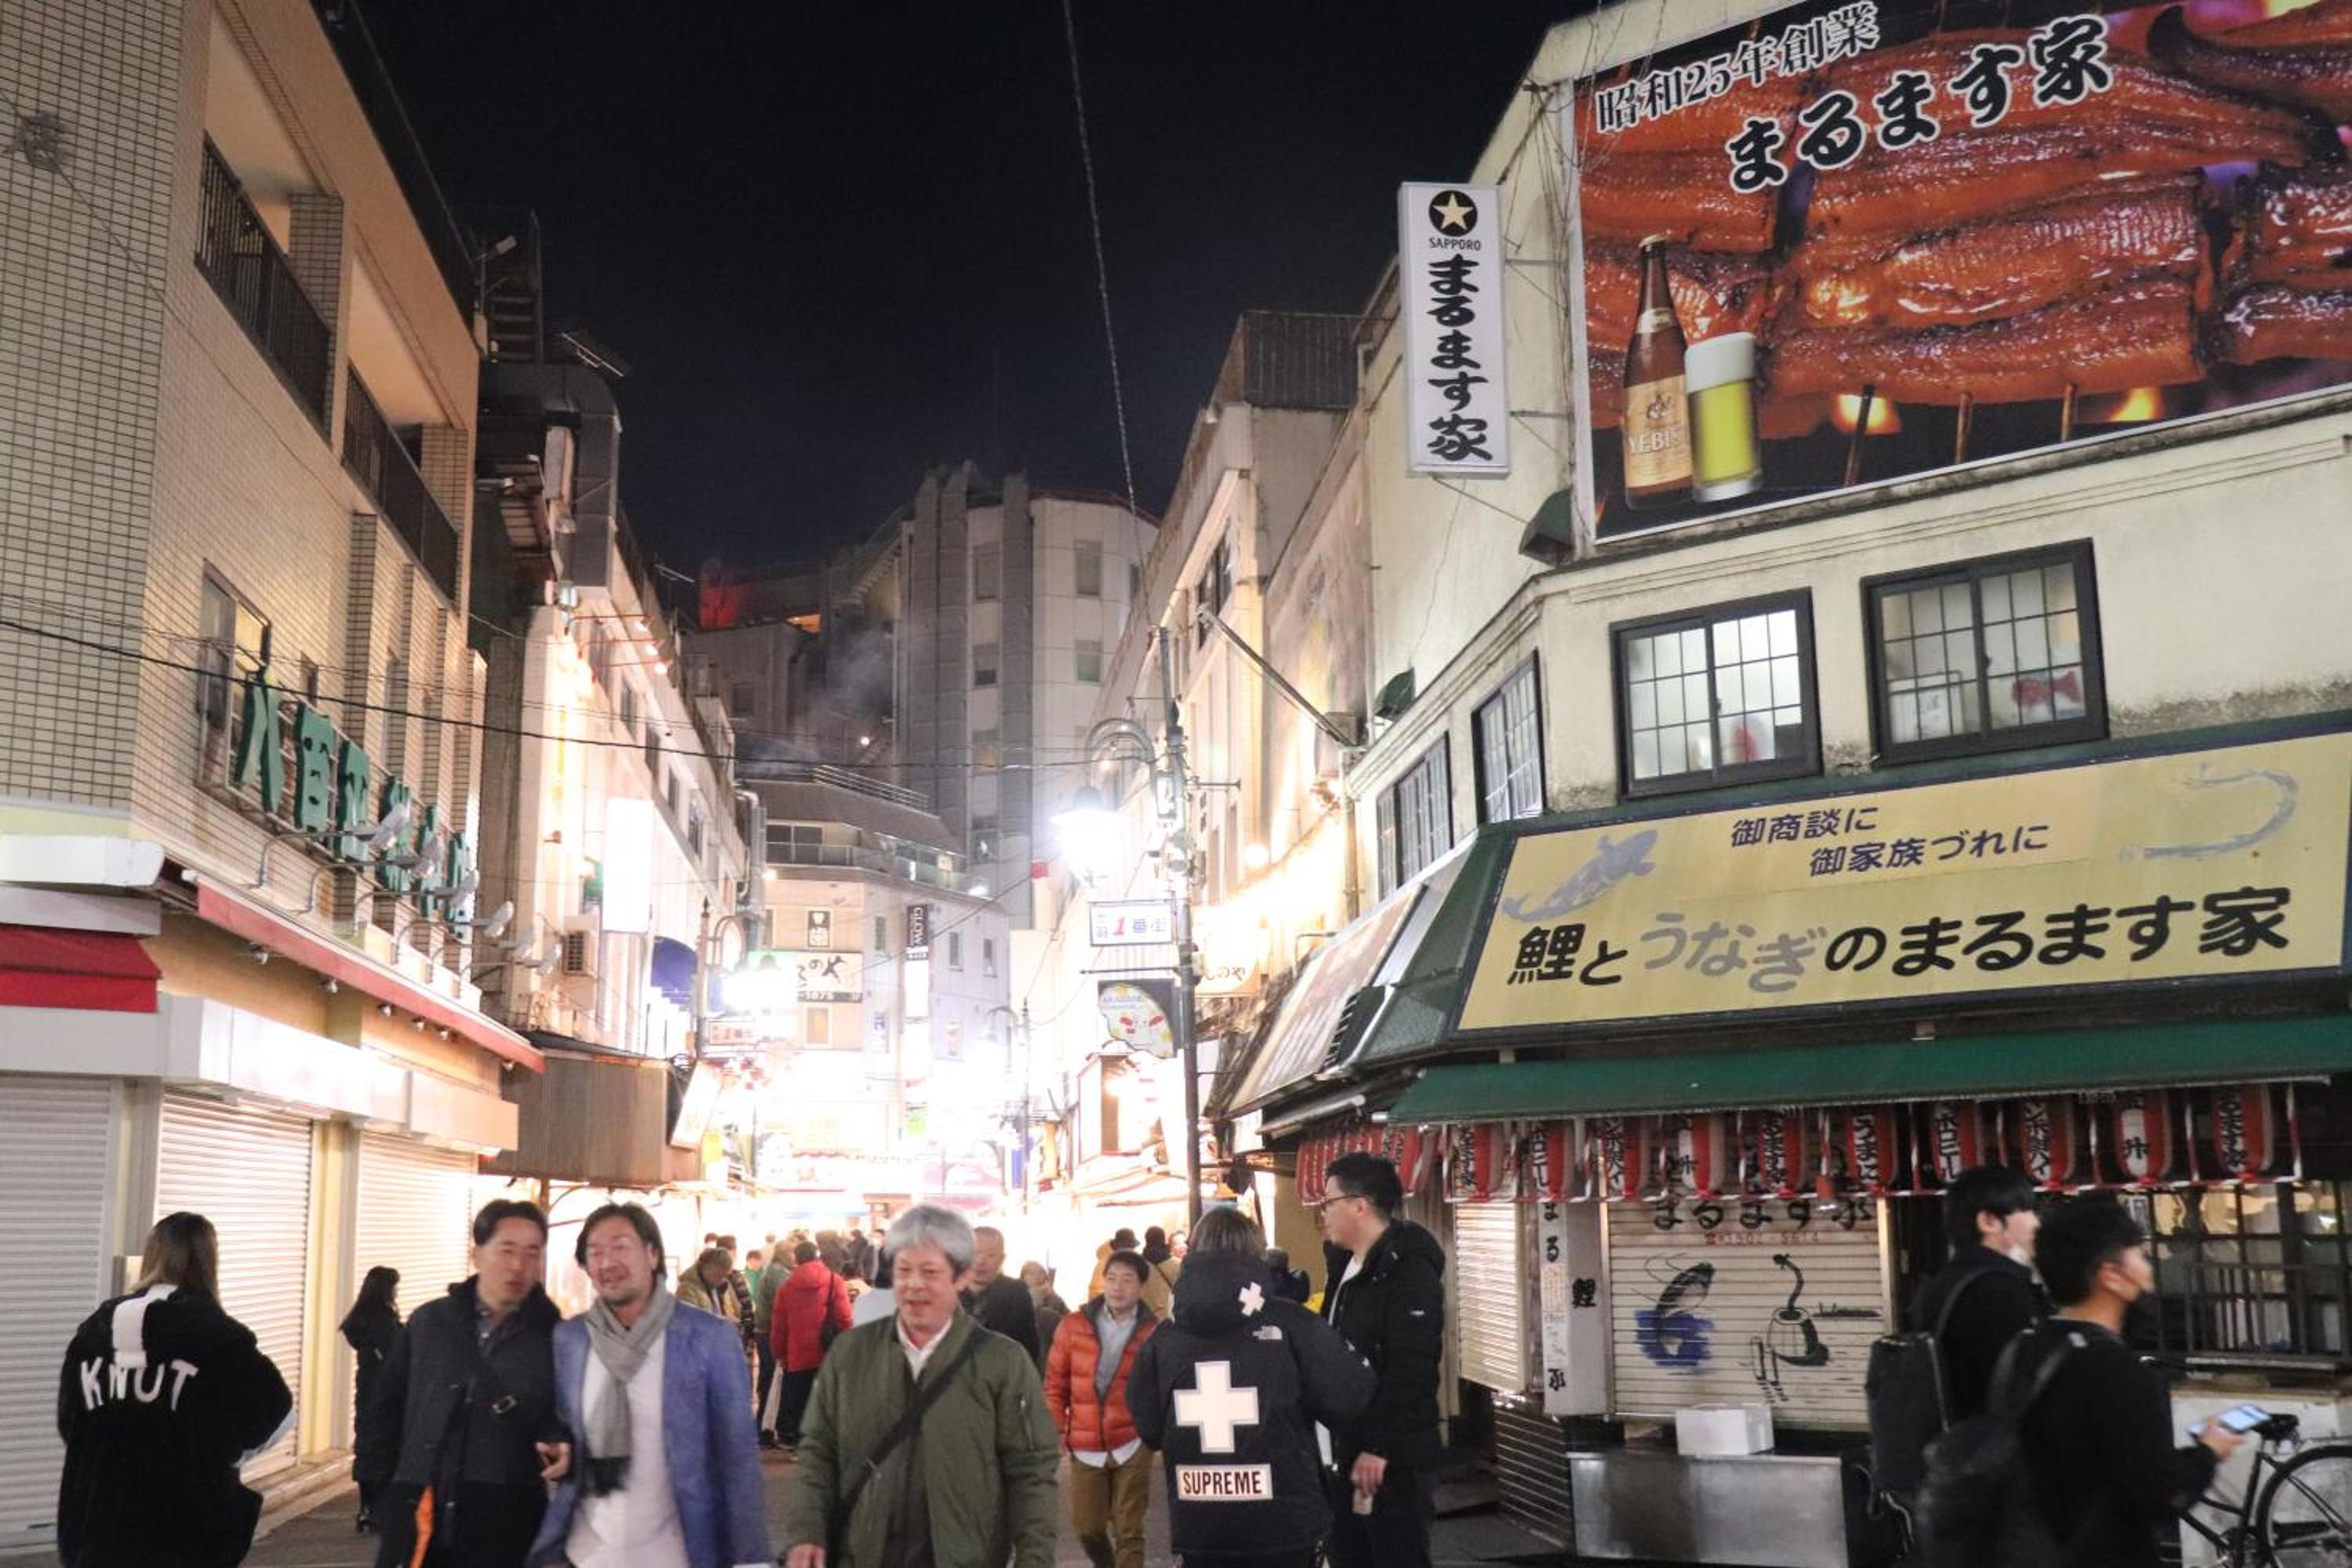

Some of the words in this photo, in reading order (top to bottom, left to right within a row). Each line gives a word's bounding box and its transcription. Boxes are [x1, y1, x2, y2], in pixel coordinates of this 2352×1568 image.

[1596, 2, 1880, 132] 昭和25年創業
[1728, 14, 2115, 193] まるます家
[1428, 237, 1482, 251] SAPPORO
[1427, 252, 1493, 462] まるます家
[1731, 806, 1878, 848] 御商談に
[1809, 825, 2050, 877] 御家族づれに
[1506, 887, 2291, 993] 鯉とうなぎのまるます家
[81, 1356, 200, 1411] KNUT
[1182, 1470, 1263, 1496] SUPREME
